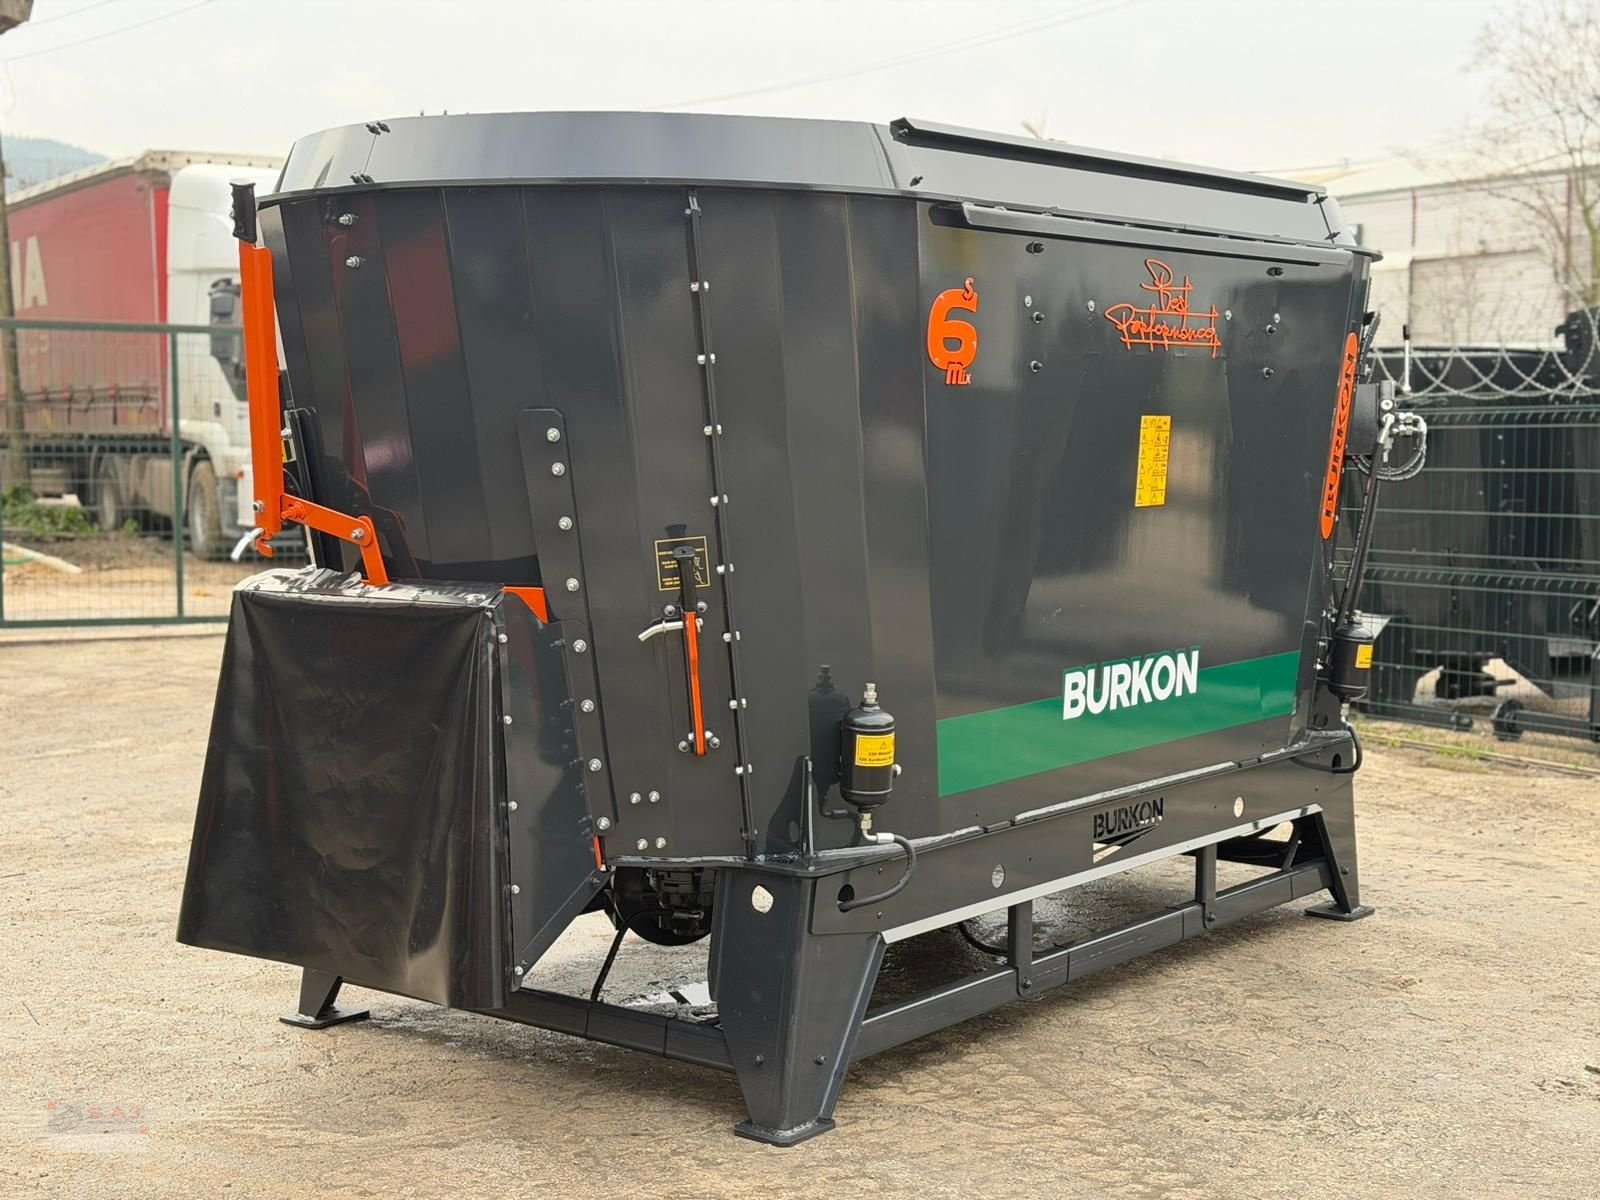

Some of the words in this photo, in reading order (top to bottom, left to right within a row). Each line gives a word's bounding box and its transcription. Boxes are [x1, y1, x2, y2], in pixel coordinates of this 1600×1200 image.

[1140, 259, 1193, 329] Best
[1063, 650, 1199, 720] BURKON
[1093, 797, 1163, 839] BURKON
